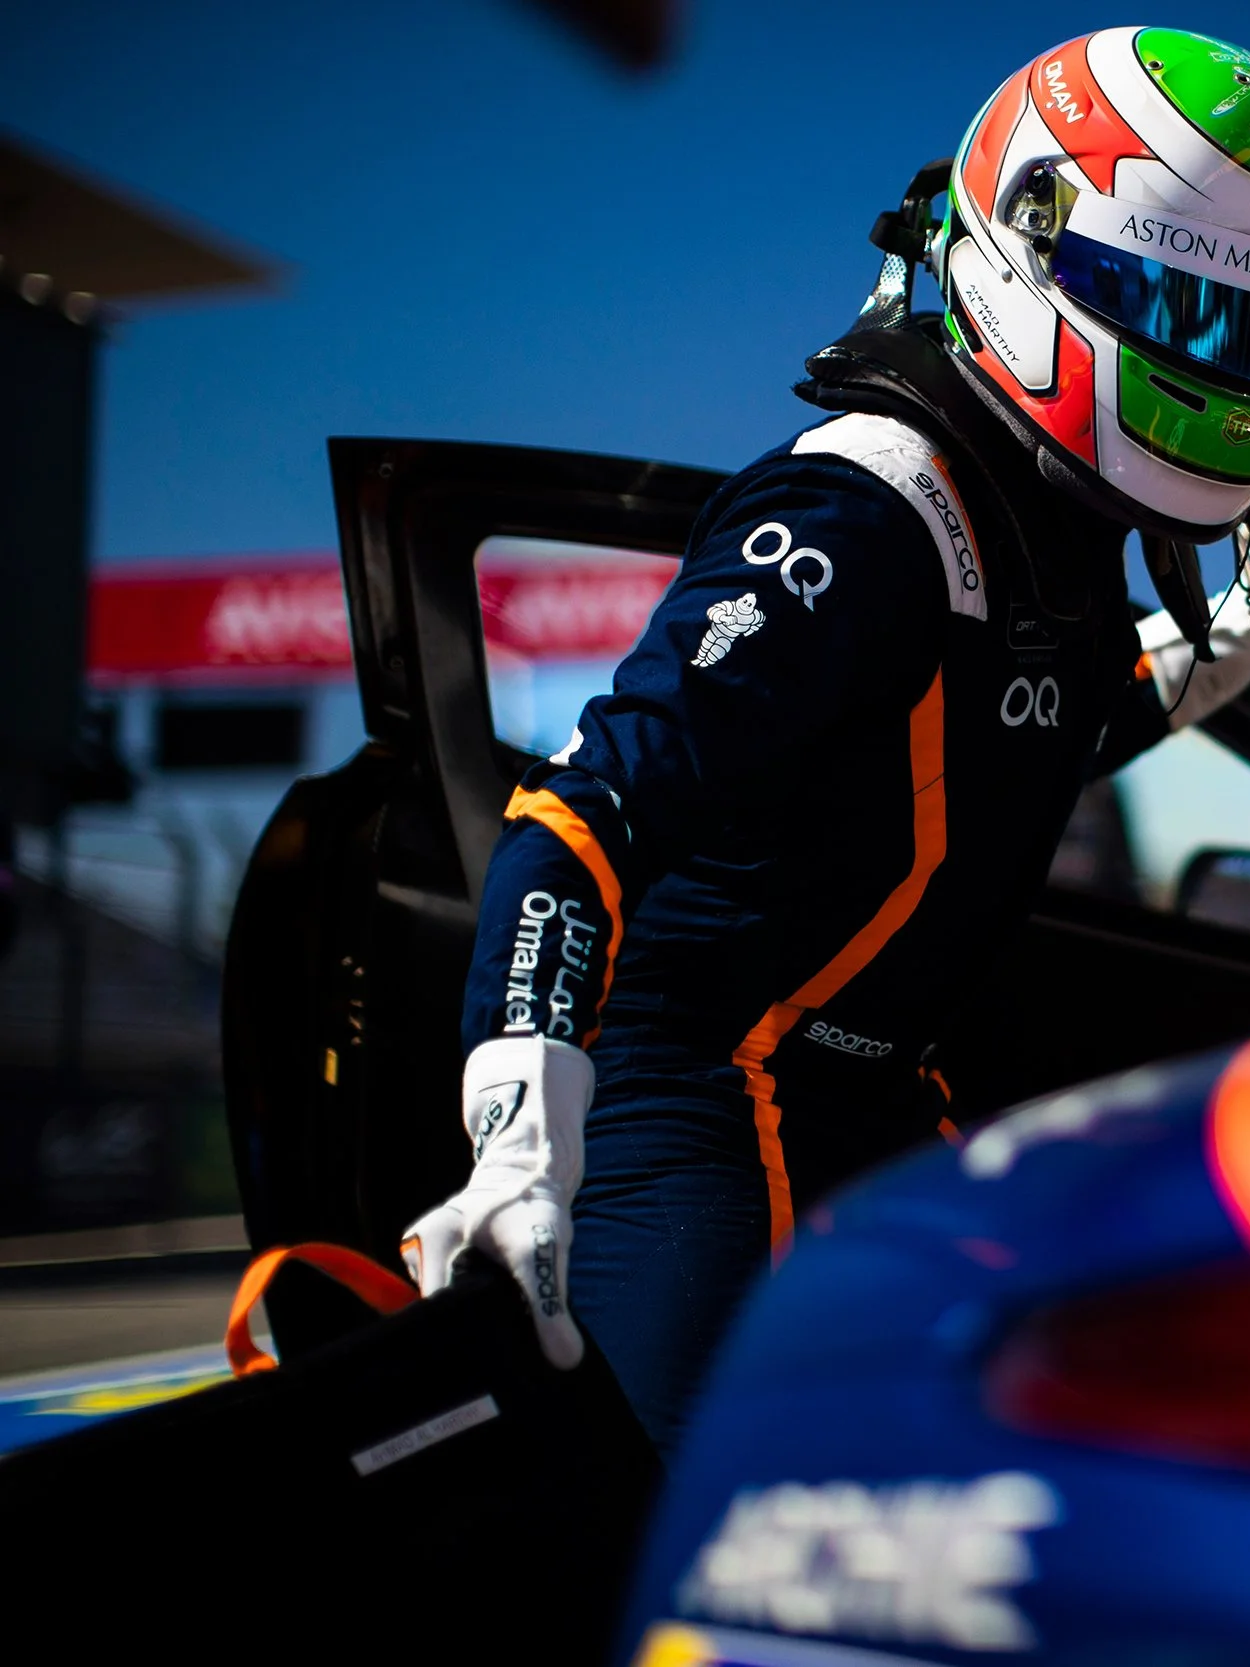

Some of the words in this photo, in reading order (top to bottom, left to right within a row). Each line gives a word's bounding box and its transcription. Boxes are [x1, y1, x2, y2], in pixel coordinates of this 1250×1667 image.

[1045, 60, 1085, 123] OMAN
[1119, 213, 1218, 262] ASTON
[977, 309, 1021, 362] HARTHY
[912, 472, 980, 593] sparco
[741, 521, 834, 612] OQ
[1000, 675, 1060, 727] OQ
[503, 890, 558, 1034] Omantel
[806, 1020, 893, 1058] sparco
